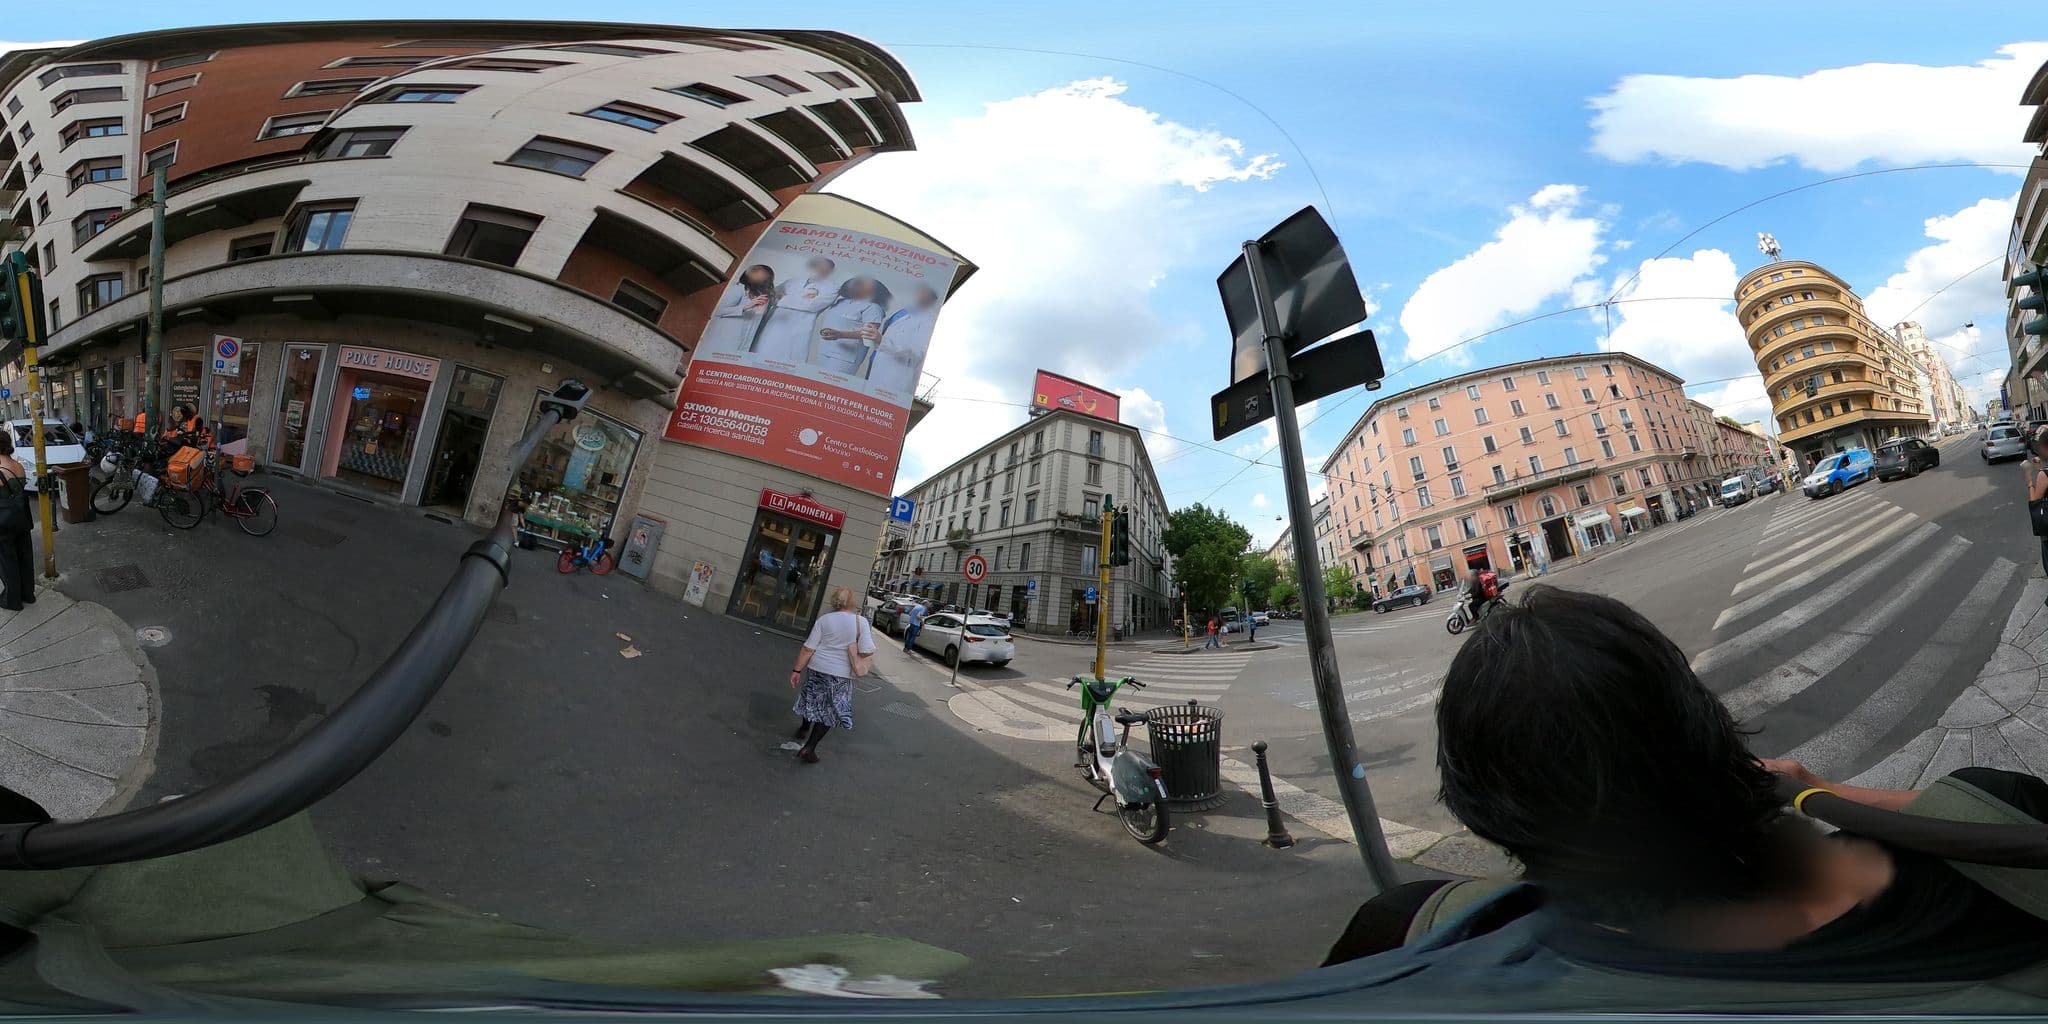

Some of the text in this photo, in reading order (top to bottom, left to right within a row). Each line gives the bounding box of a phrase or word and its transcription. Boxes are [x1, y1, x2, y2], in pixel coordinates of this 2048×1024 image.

[779, 226, 937, 265] SIAMO IL MONZINO
[785, 244, 926, 280] NON HA FUTURO
[344, 352, 432, 376] POKE HOUSE
[706, 370, 732, 379] CENTRO
[732, 374, 785, 388] CARDIOLOGICO
[784, 383, 818, 397] MONZINO
[826, 392, 848, 406] BATTE
[848, 400, 863, 410] PER
[863, 404, 870, 412] IL
[870, 407, 895, 421] CUORE.
[736, 382, 762, 392] SOSTIENI
[769, 388, 795, 400] RICERCA
[800, 396, 817, 405] DONA
[824, 402, 836, 411] TUO
[836, 406, 858, 417] 5X1000
[680, 411, 768, 437] C.F. 13055640158
[684, 402, 718, 414] 5X1000
[728, 409, 771, 426] Monzino
[677, 421, 766, 445] casella ricerca sanitaria
[822, 444, 851, 457] Monzino
[825, 436, 889, 461] Centro Cardiologico
[772, 497, 834, 522] LA PIADINERIA
[895, 500, 910, 516] P
[968, 561, 982, 576] 30
